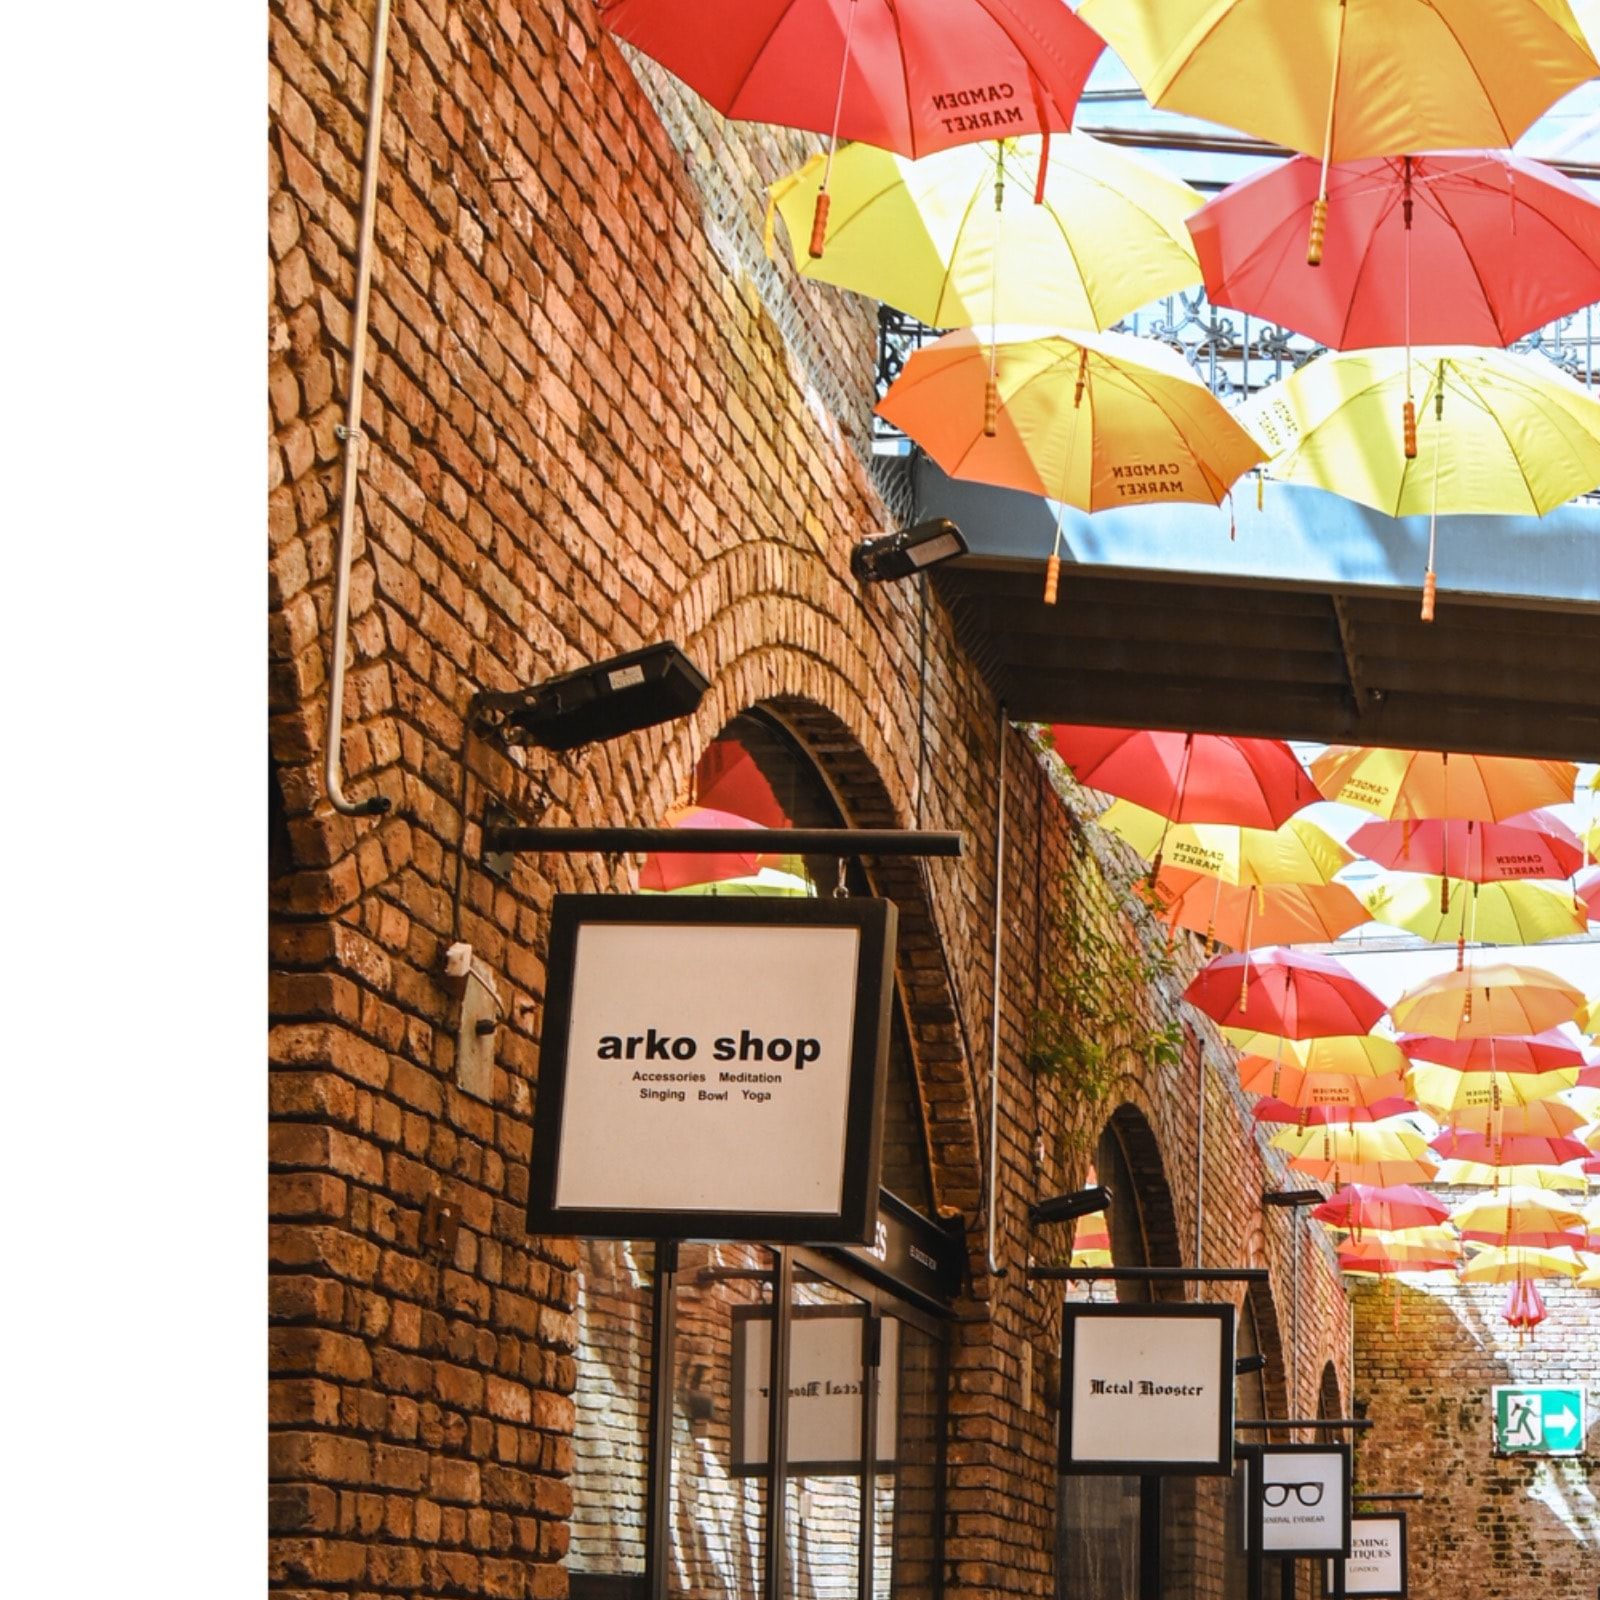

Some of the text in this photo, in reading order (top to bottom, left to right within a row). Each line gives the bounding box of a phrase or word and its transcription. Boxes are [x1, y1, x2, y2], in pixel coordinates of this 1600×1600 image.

[597, 1029, 821, 1070] arko shop
[632, 1071, 782, 1084] Accessories Meditation
[640, 1088, 771, 1103] Singing Bowl Yoga
[1090, 1378, 1203, 1396] Metal Rooster
[1352, 1539, 1390, 1547] EMING
[1353, 1549, 1392, 1560] TIQUES
